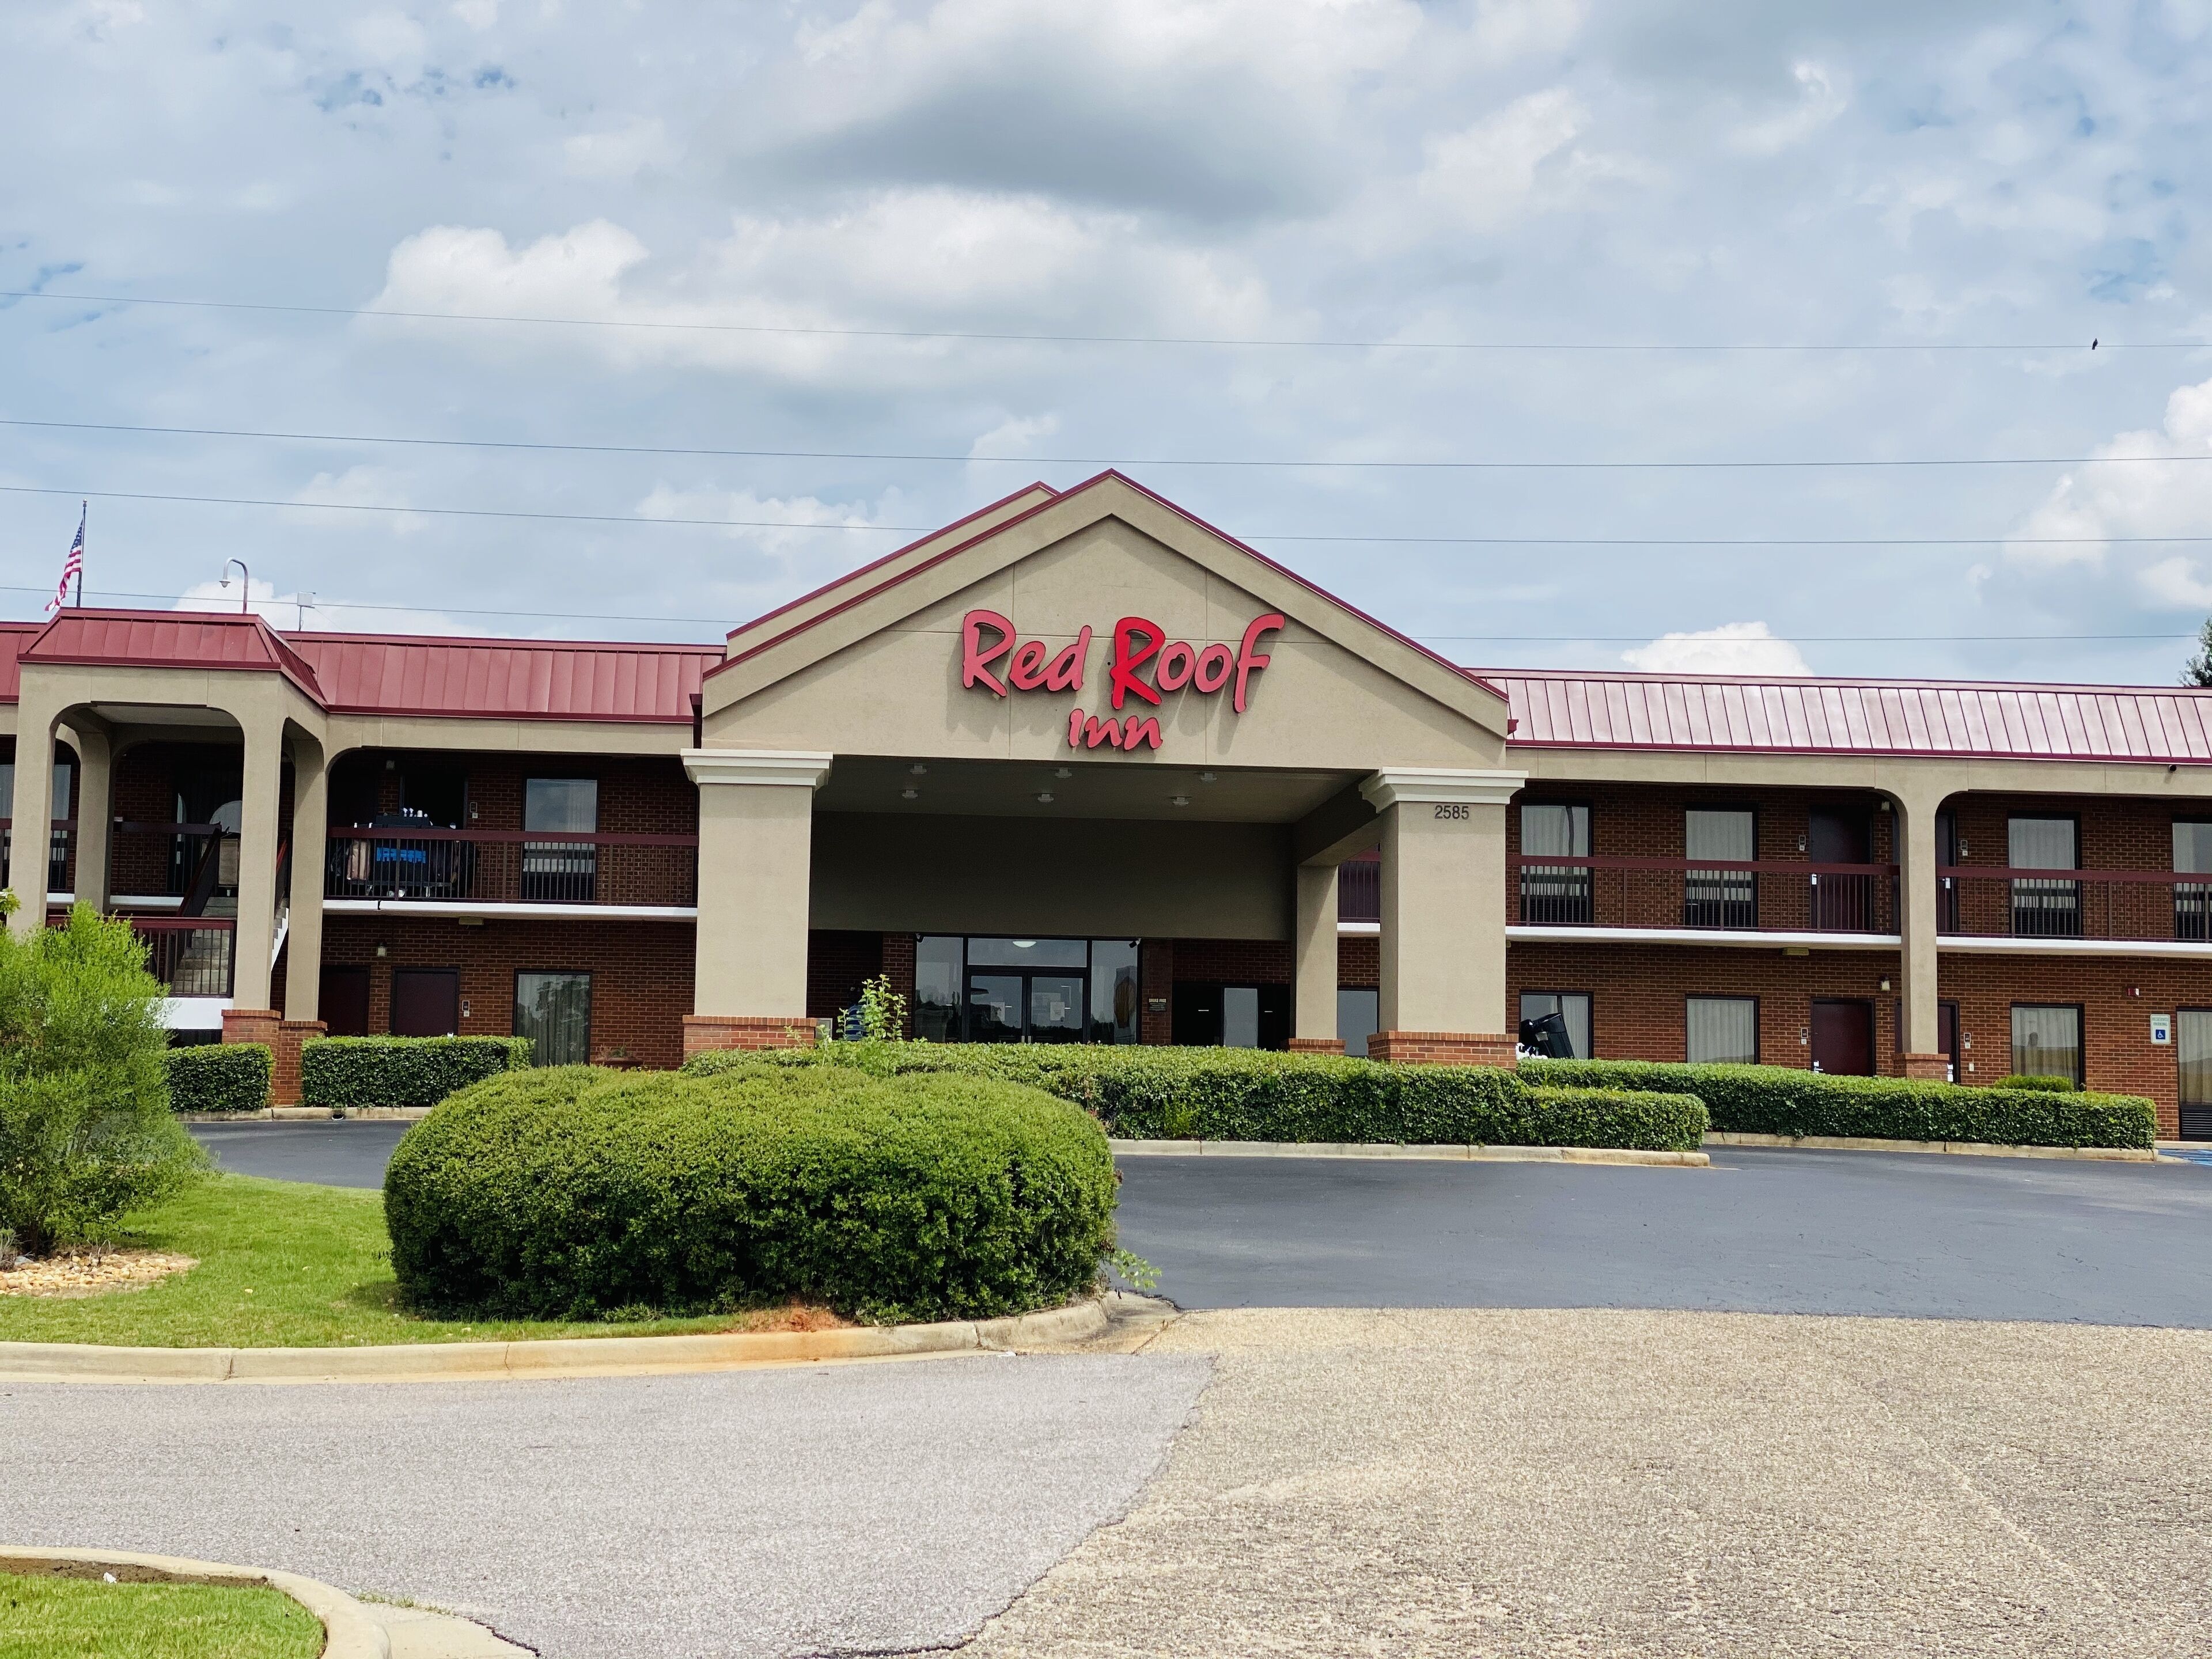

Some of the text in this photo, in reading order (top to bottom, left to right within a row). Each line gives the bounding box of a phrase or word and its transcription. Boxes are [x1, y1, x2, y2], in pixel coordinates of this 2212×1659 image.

[963, 609, 1286, 713] Red Roof
[1067, 708, 1164, 750] Inn
[1434, 805, 1469, 820] 2585
